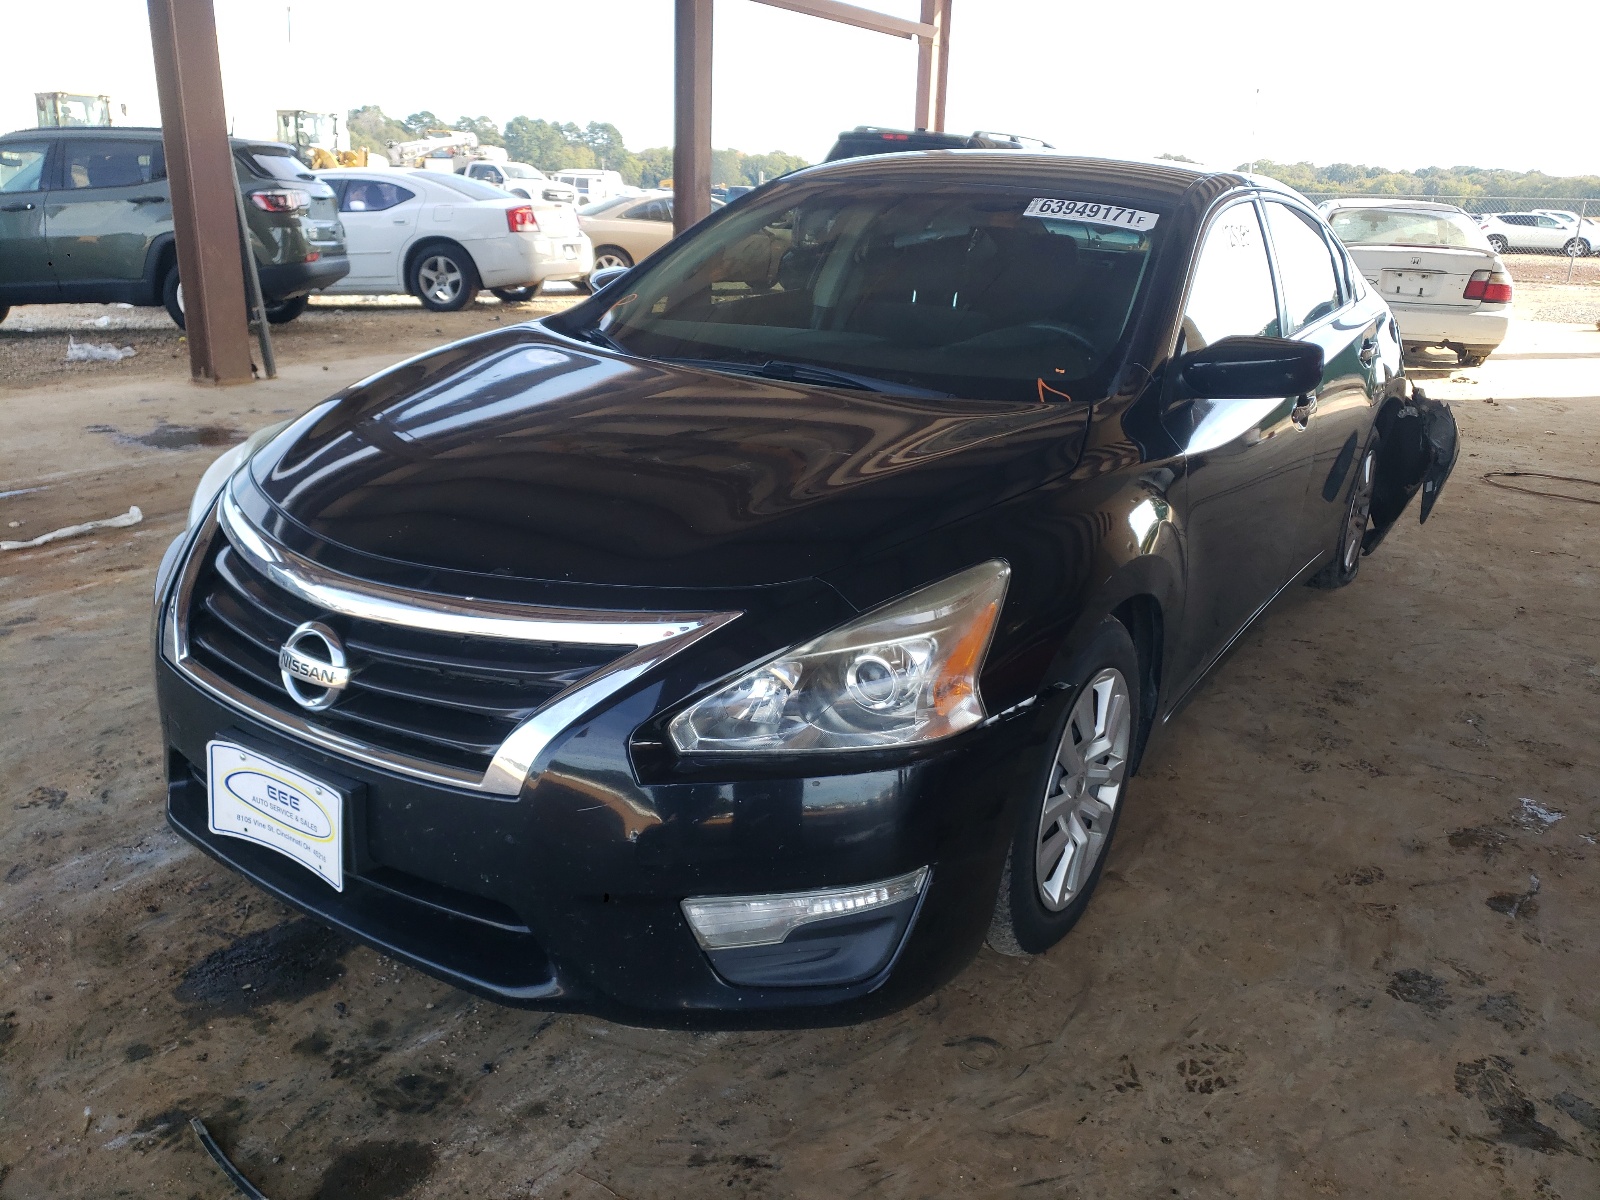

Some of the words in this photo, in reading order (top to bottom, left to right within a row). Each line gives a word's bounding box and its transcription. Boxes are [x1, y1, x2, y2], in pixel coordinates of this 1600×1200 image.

[1038, 199, 1136, 224] 63949171
[282, 652, 334, 684] NISSAN
[267, 784, 300, 812] EEE
[236, 814, 252, 824] 8105
[252, 819, 267, 830] Vine
[252, 795, 269, 808] AUTO
[269, 802, 294, 820] SERVICE
[300, 817, 318, 833] SALES
